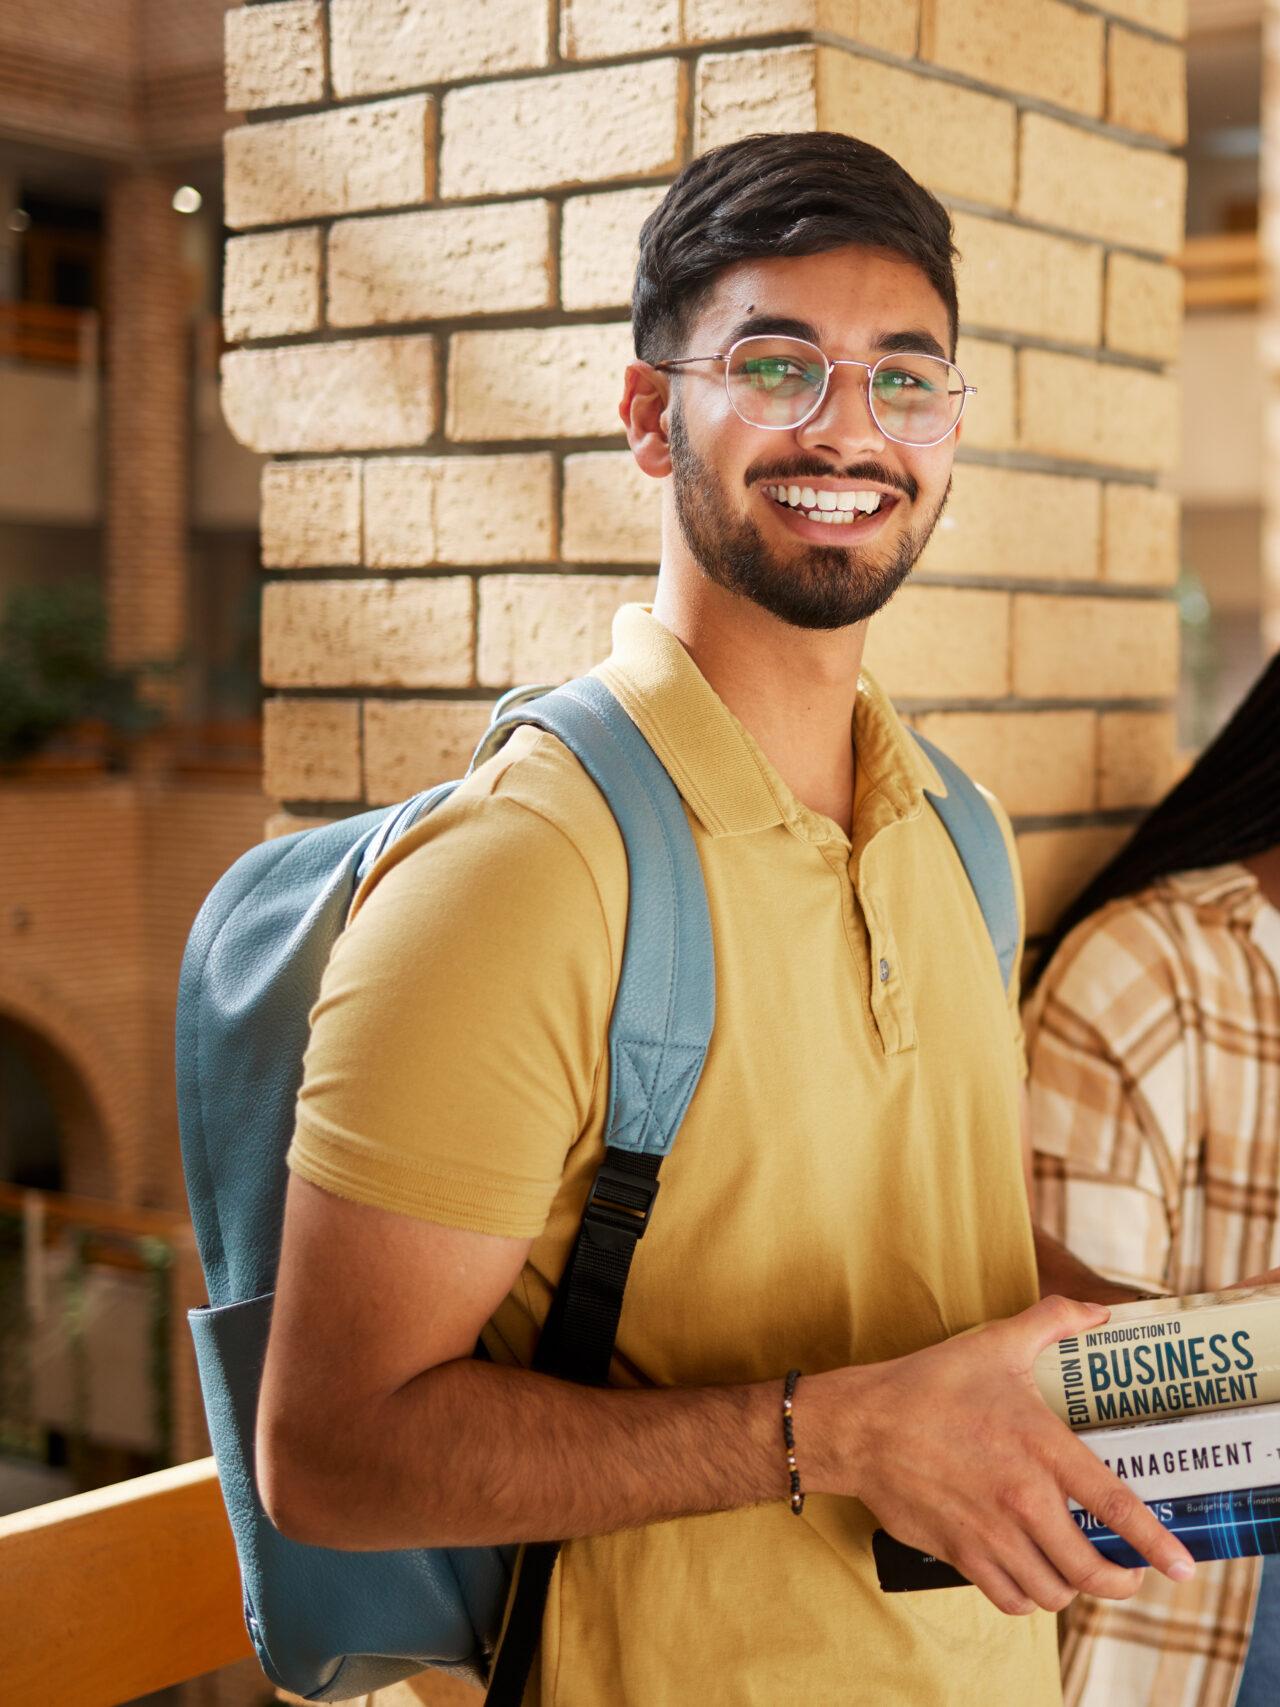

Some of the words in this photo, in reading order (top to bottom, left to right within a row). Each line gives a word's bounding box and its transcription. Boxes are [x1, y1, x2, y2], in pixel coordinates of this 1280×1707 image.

[1058, 1337, 1079, 1354] III
[1086, 1325, 1164, 1347] INTRODUCTION
[1166, 1321, 1181, 1336] TO
[1087, 1331, 1254, 1392] BUSINESS
[1060, 1358, 1090, 1425] EDITION
[1094, 1373, 1258, 1421] MANAGEMENT
[1187, 1500, 1230, 1513] Budgeting
